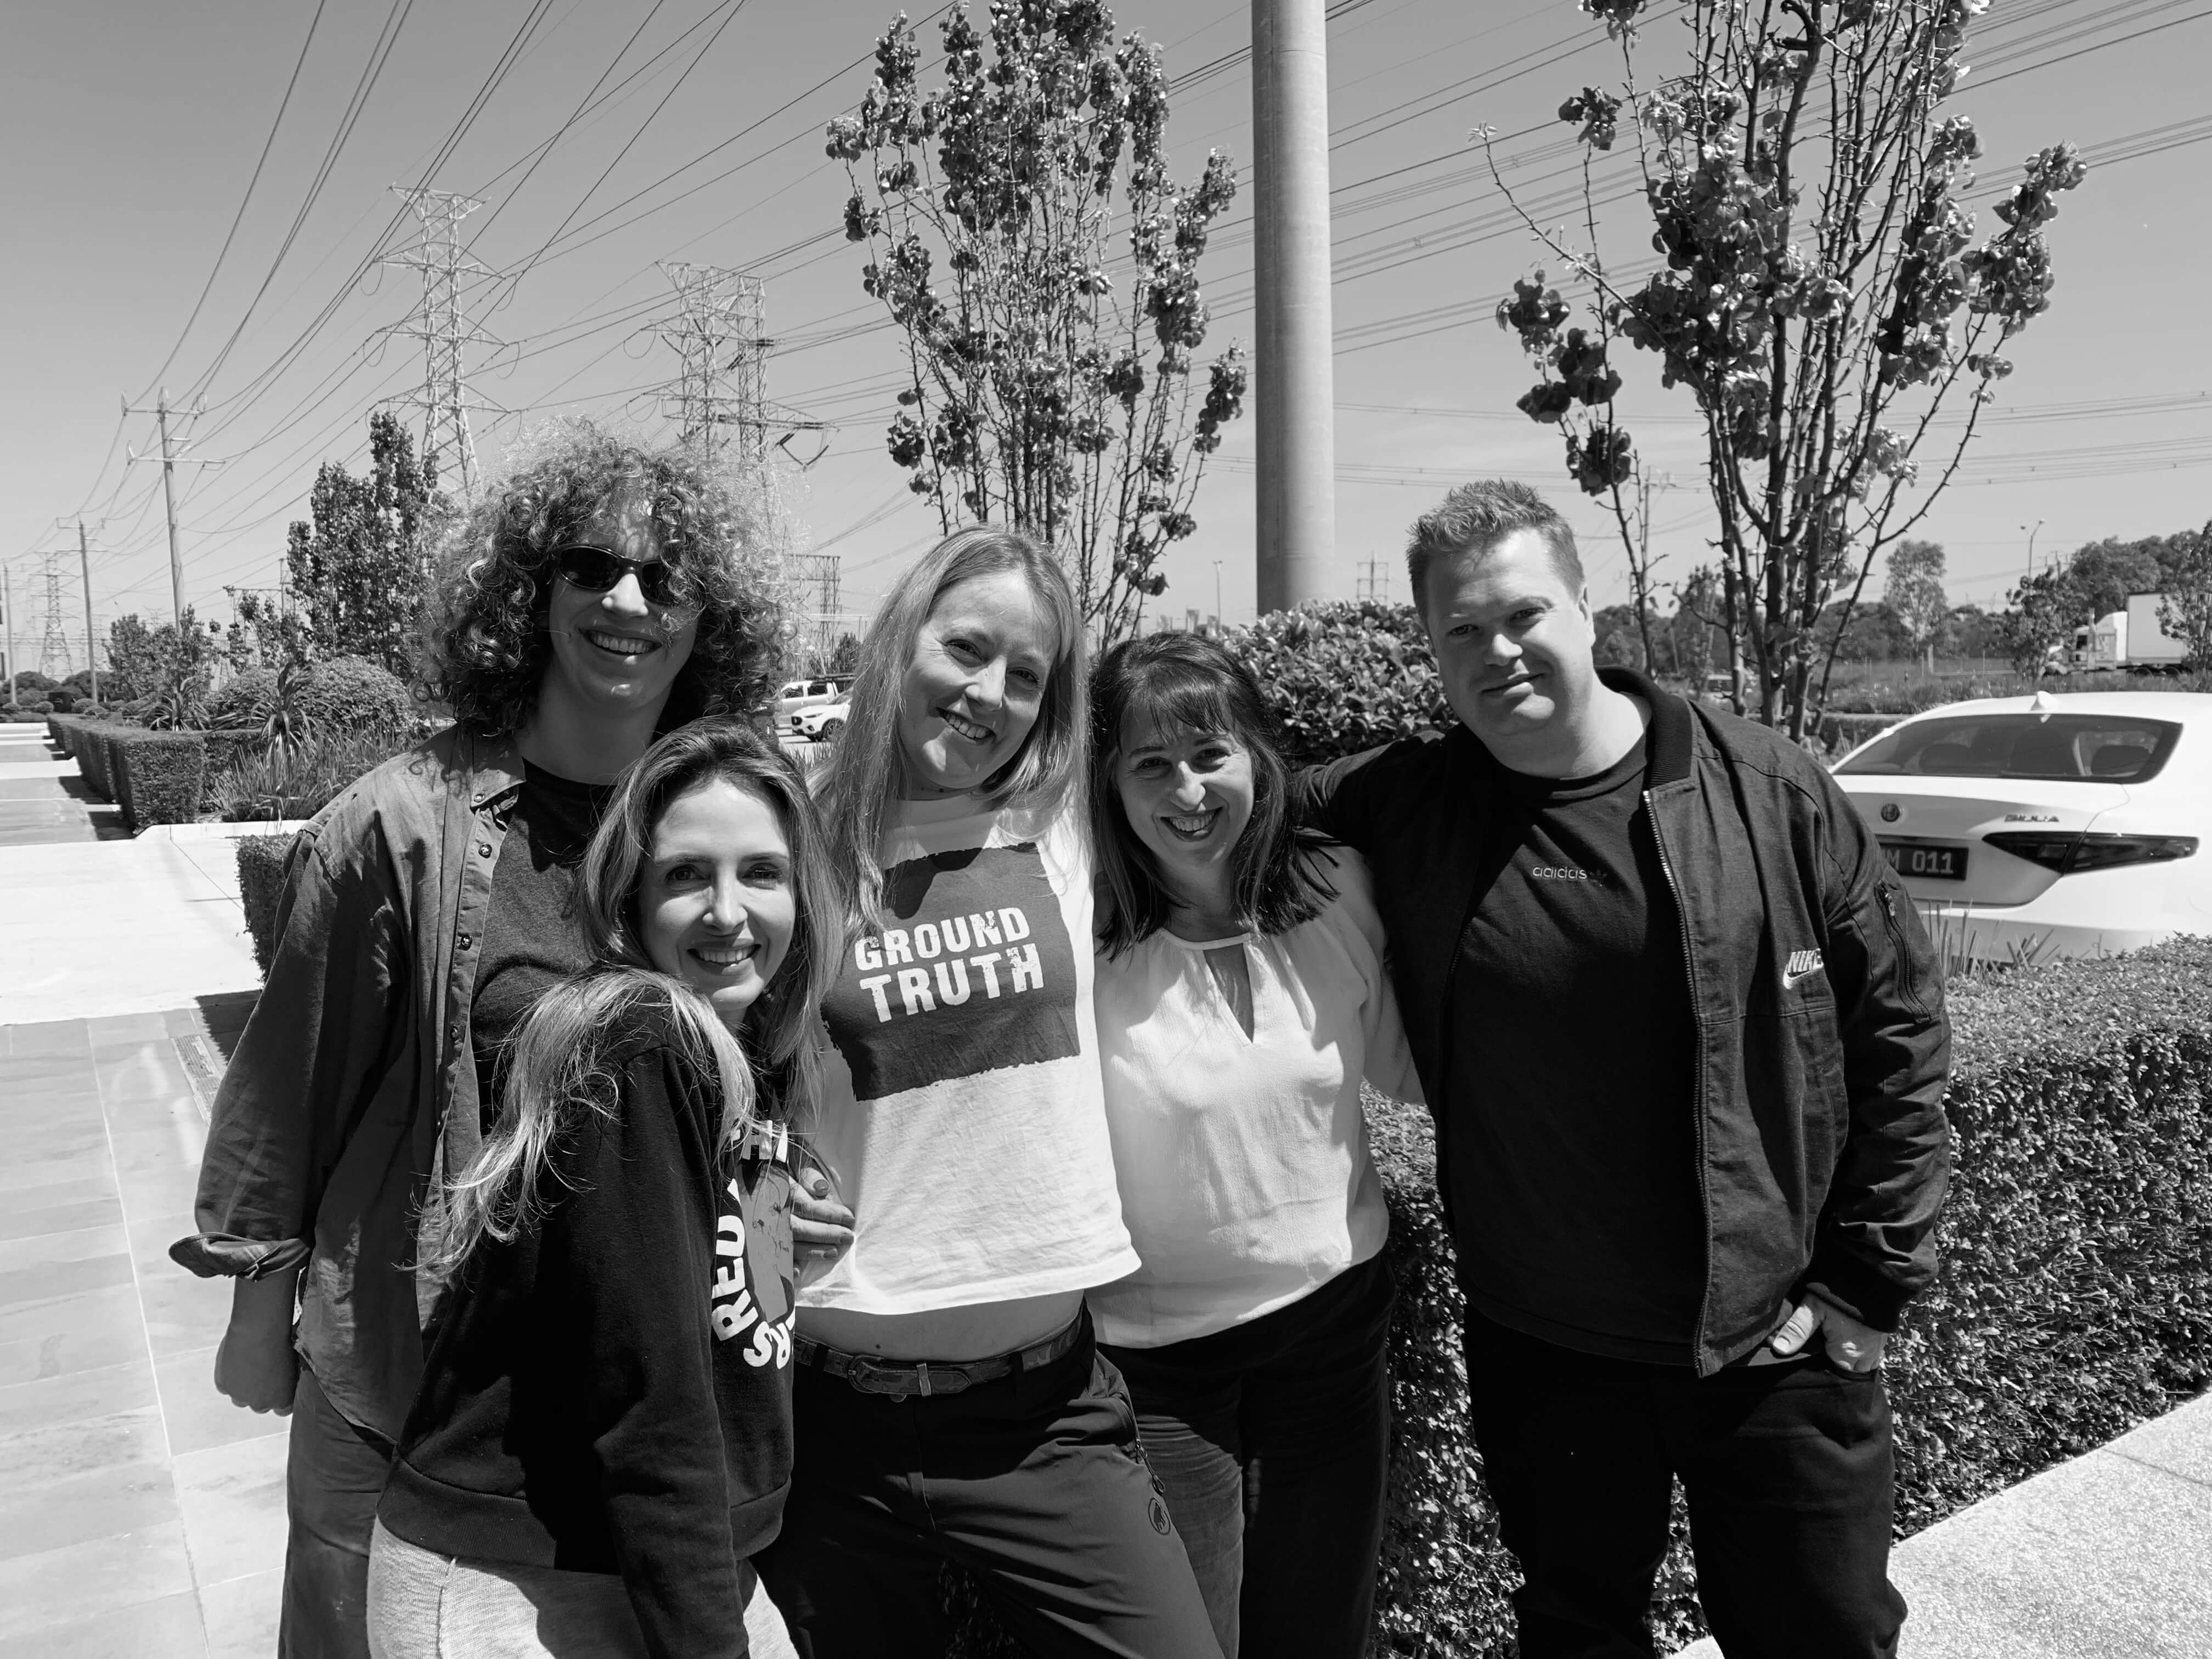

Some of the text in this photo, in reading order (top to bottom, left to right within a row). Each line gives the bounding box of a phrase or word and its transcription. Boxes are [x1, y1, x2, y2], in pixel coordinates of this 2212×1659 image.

[1532, 866, 1588, 879] adidas
[1912, 850, 1954, 874] 011
[854, 907, 1030, 971] GROUND
[859, 943, 1044, 1023] TRUTH
